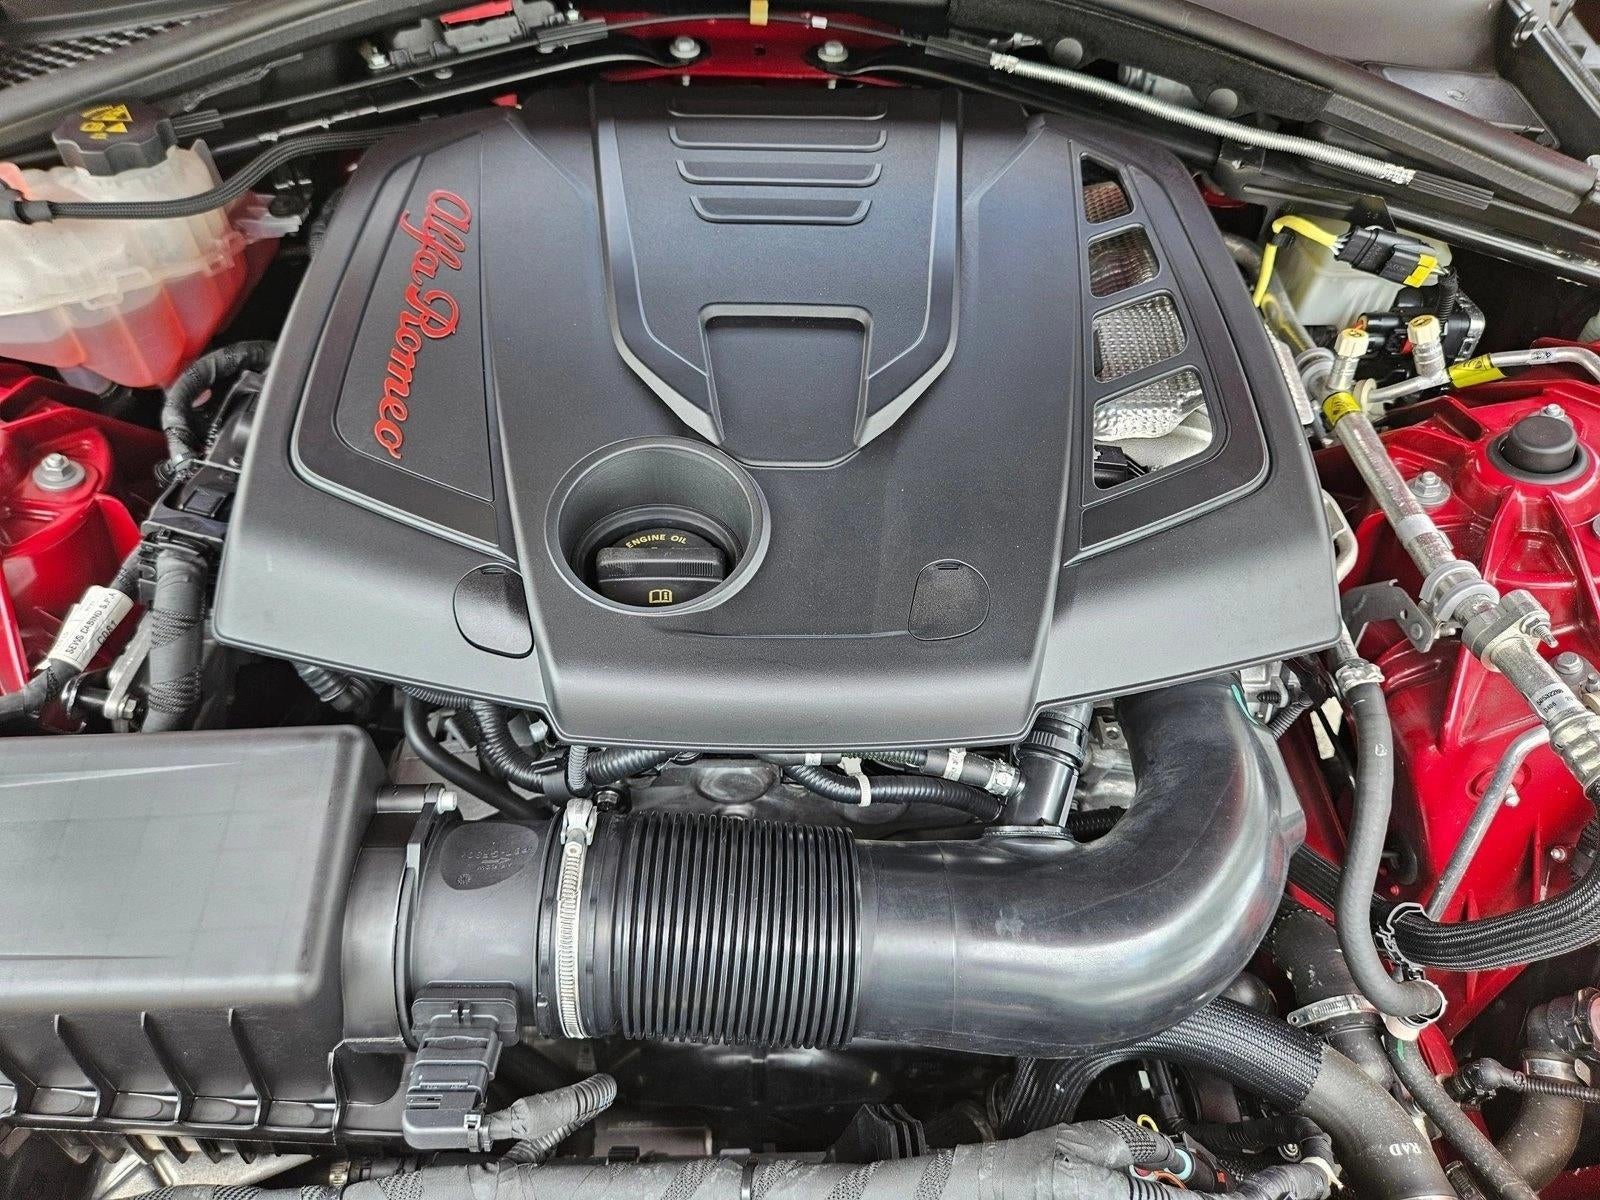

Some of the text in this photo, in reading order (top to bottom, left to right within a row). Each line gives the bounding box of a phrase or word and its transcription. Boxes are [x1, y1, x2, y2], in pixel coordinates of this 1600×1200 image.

[374, 189, 472, 460] Alfa Romeo
[625, 534, 687, 548] ENGINE OIL
[1389, 1142, 1421, 1156] RAD
